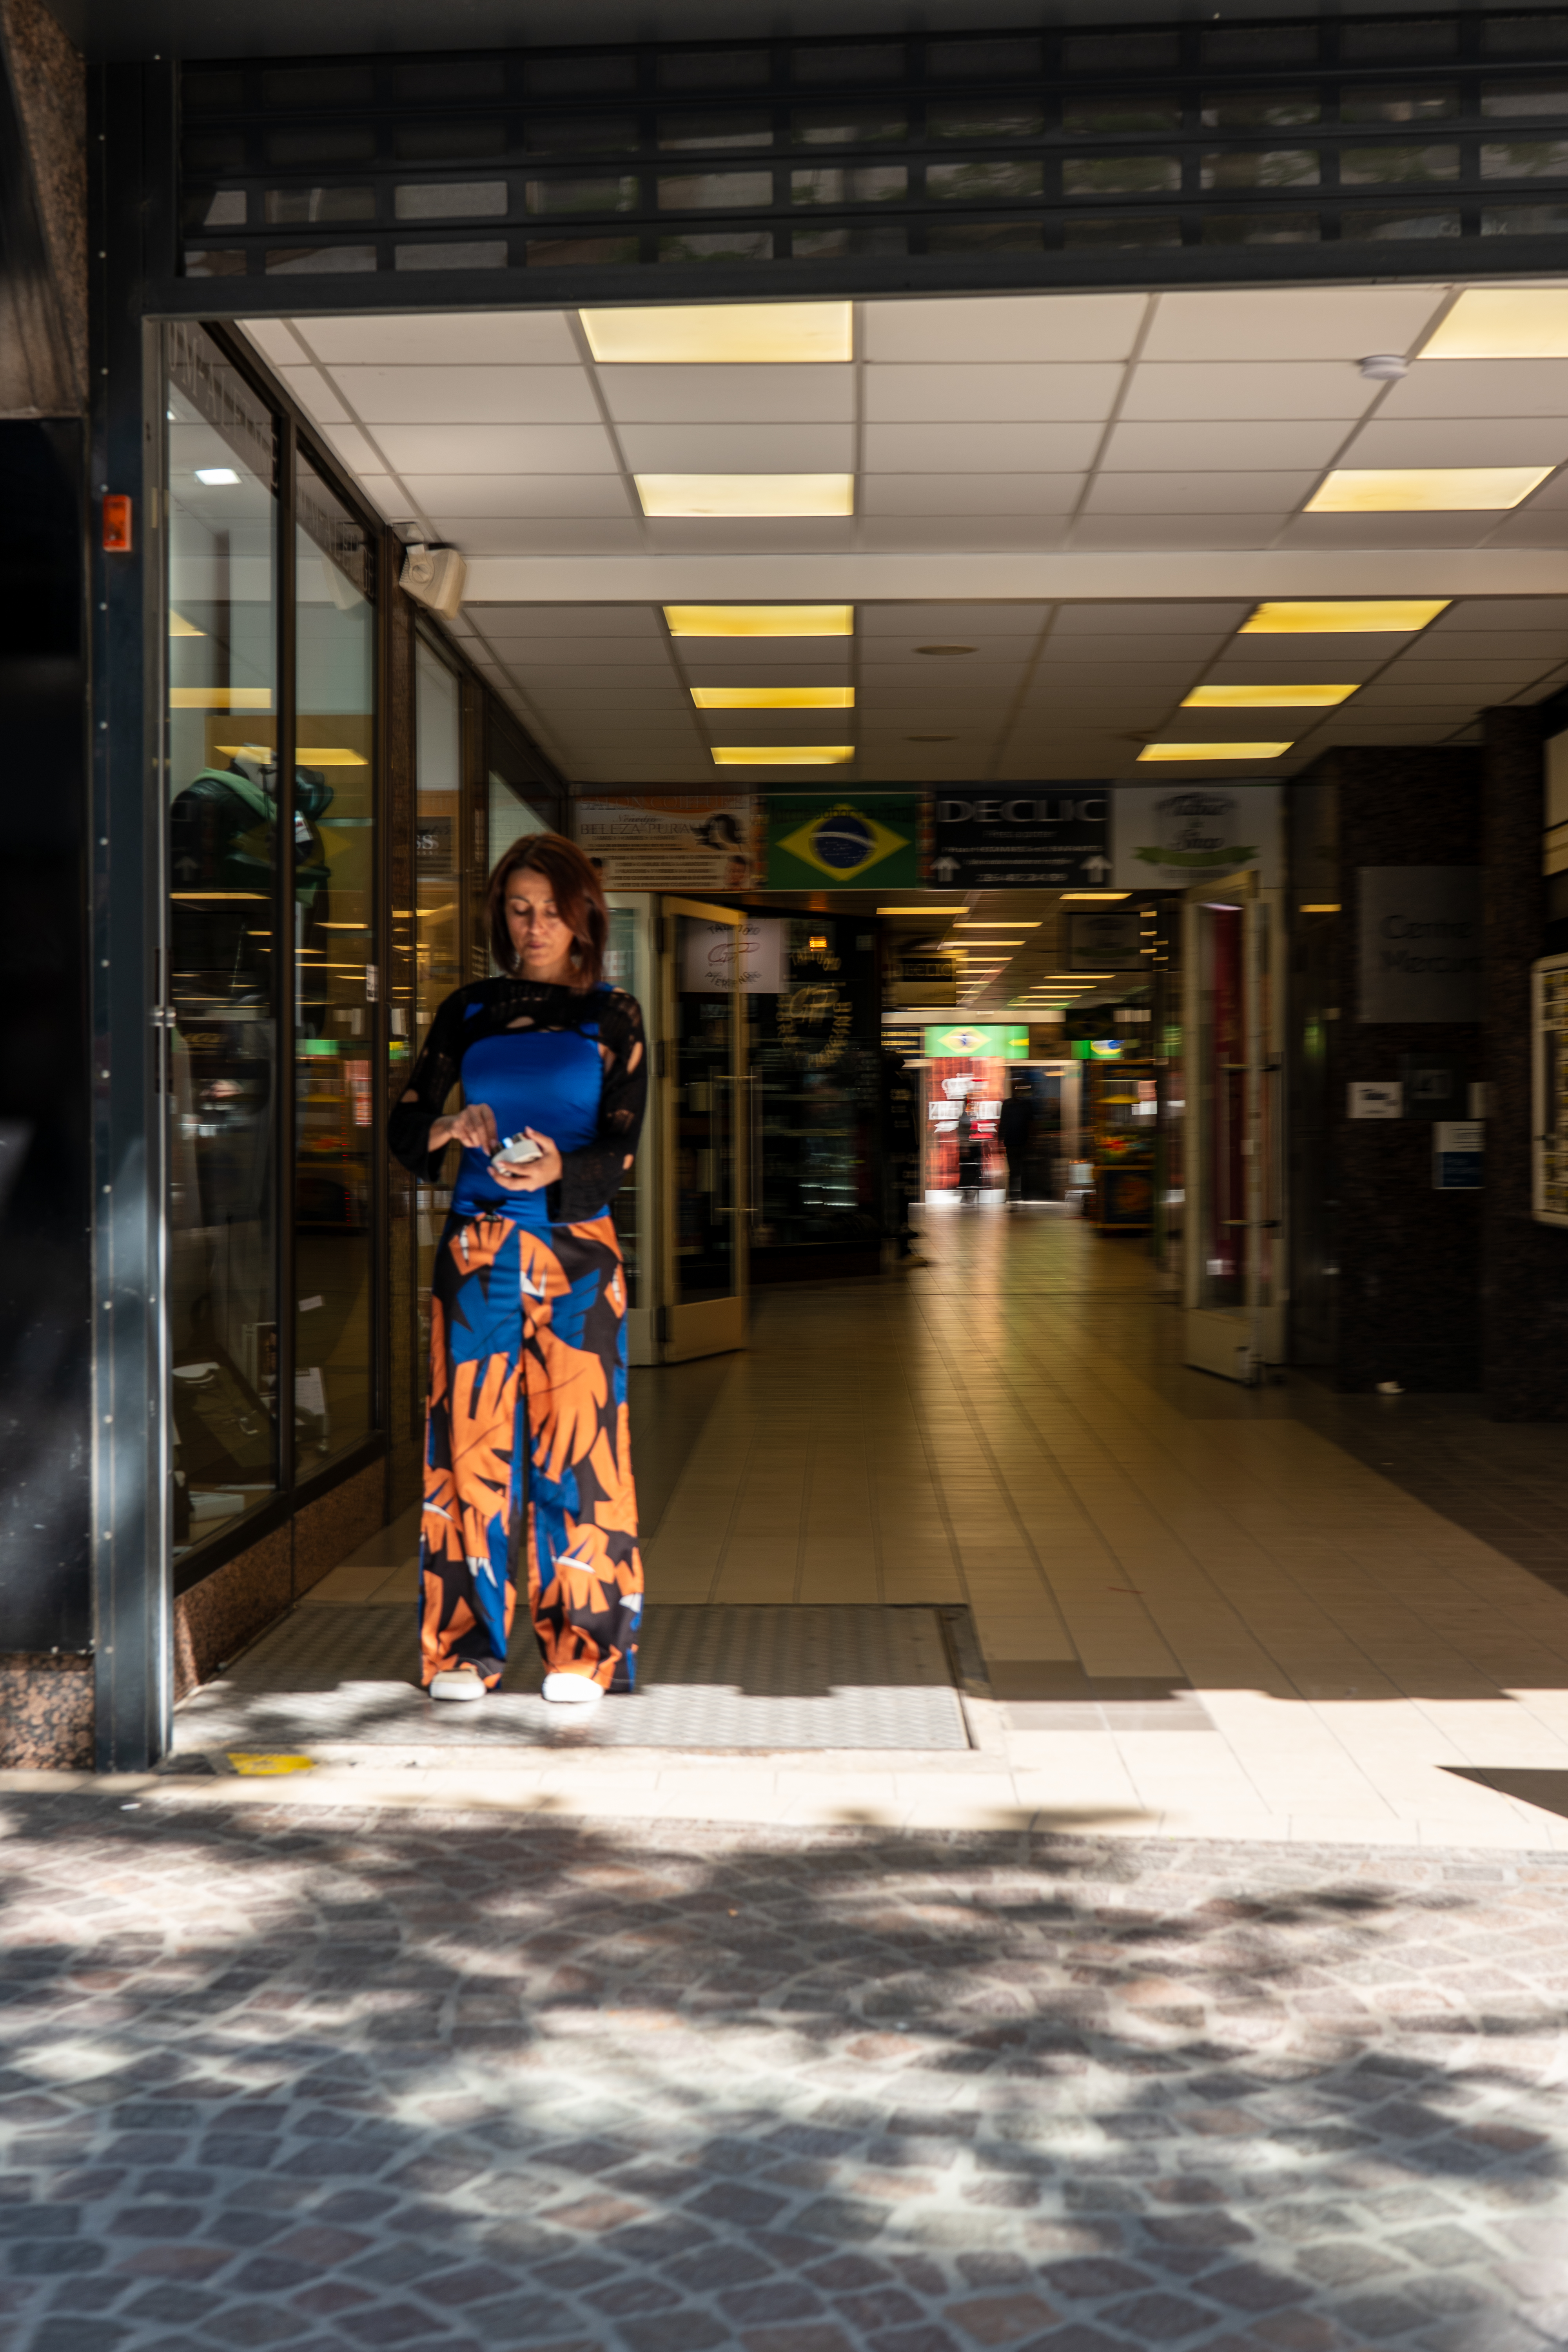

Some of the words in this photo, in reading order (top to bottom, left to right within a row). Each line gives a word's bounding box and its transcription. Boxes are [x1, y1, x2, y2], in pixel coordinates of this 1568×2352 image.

[581, 796, 648, 810] SALON
[651, 795, 750, 809] COIFFURE
[936, 799, 1109, 822] DECLIC
[581, 824, 643, 835] BELEZA
[648, 823, 691, 834] PURA
